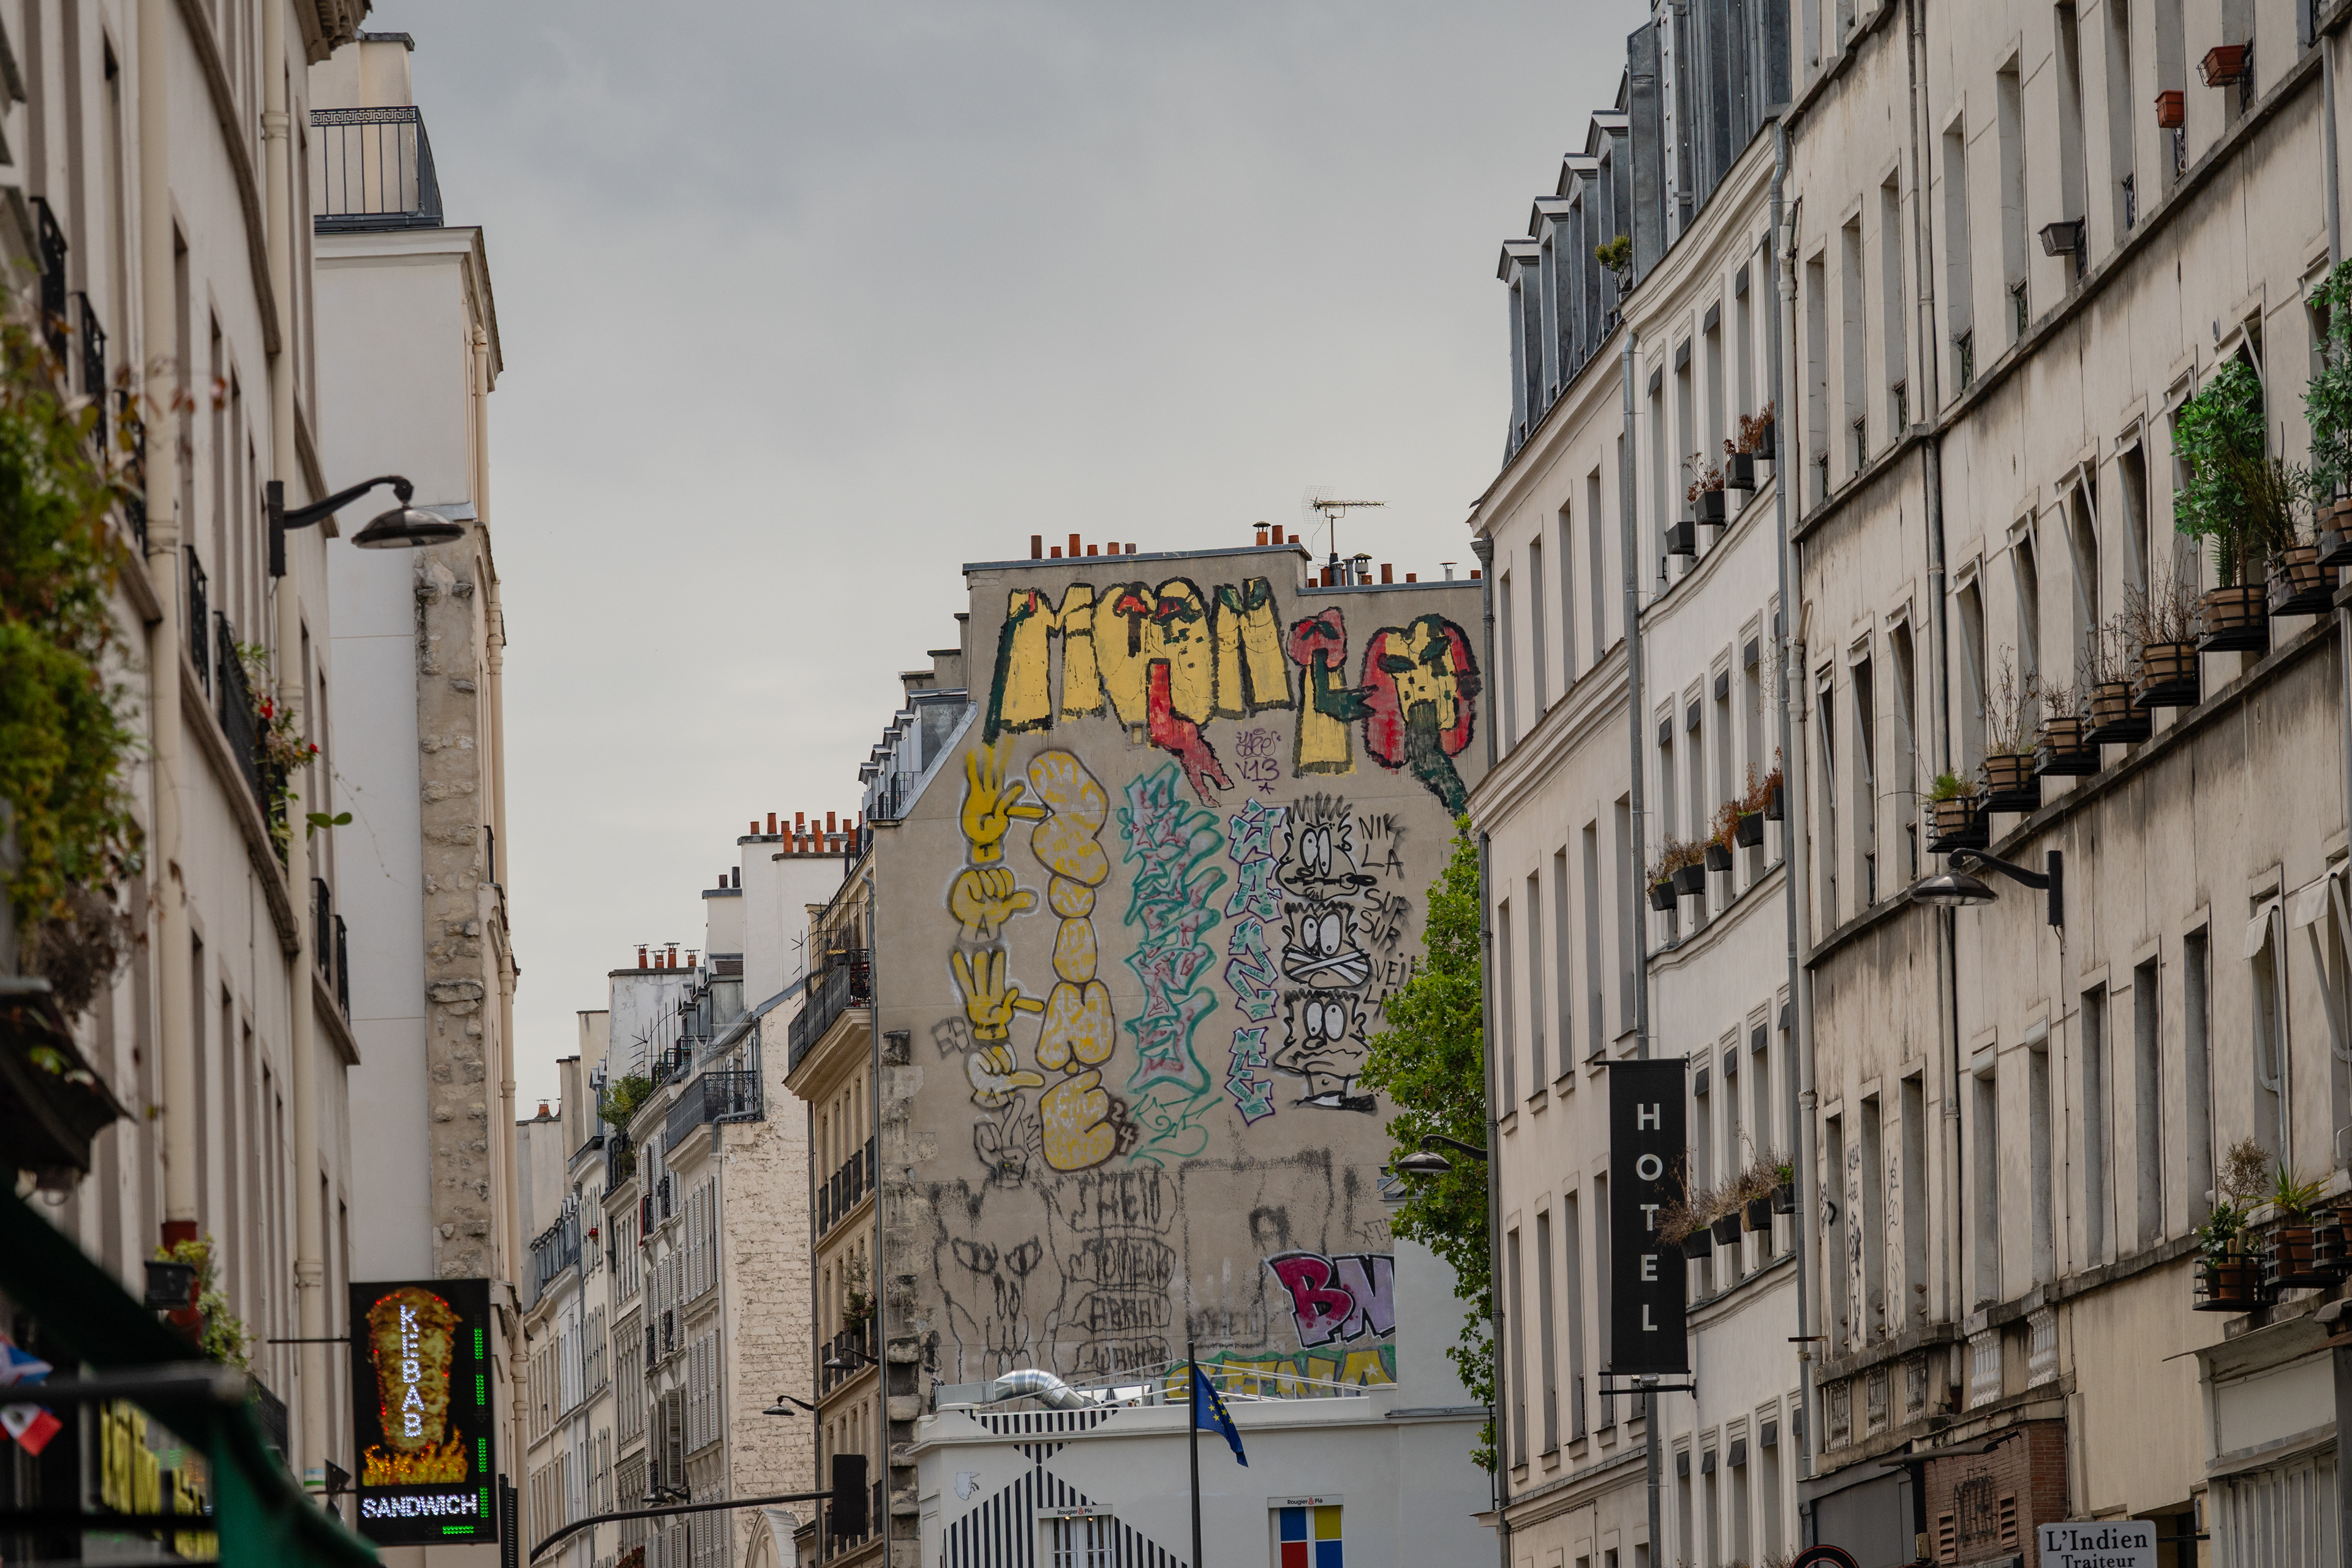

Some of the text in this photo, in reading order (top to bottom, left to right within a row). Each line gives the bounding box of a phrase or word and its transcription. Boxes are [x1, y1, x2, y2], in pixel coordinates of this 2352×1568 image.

[1636, 1103, 1663, 1331] HOTEL
[400, 1305, 424, 1437] KEBAB
[362, 1493, 477, 1518] SANDWICH
[2061, 1553, 2136, 1568] Traiteur
